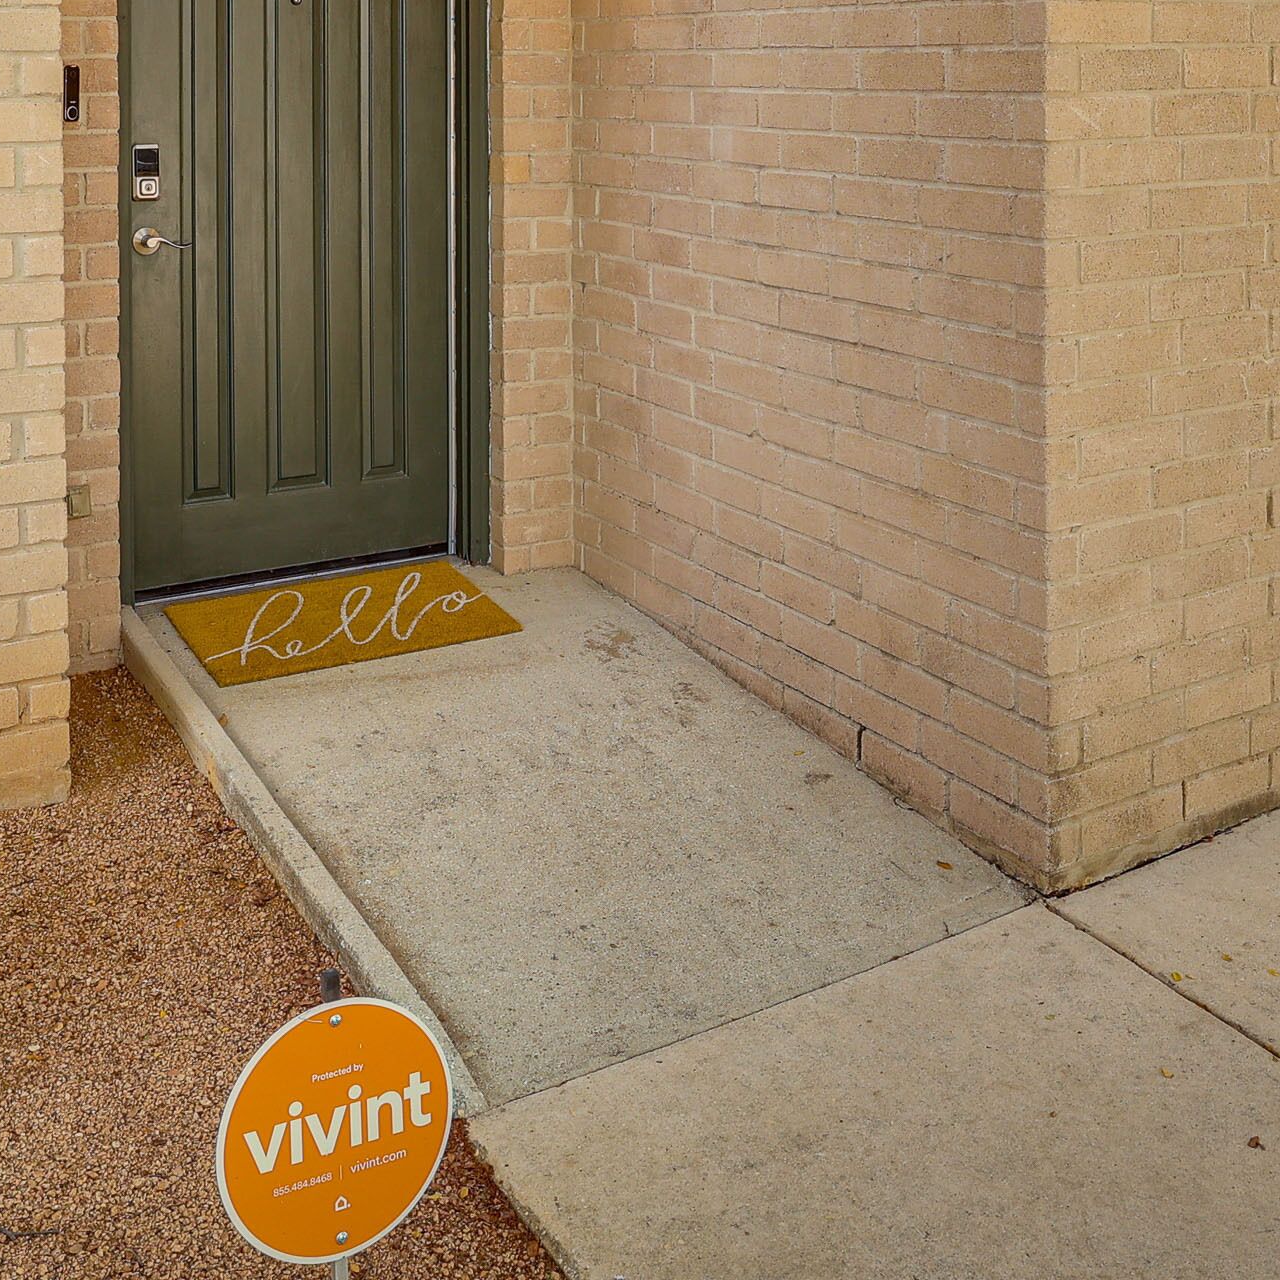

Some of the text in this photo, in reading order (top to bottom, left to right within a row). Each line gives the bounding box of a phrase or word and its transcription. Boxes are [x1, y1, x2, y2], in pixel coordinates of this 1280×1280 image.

[204, 572, 486, 666] hello
[311, 1063, 364, 1083] Protected by
[243, 1071, 432, 1175] vivint
[272, 1149, 407, 1197] 855.484.8468 vivint.com
